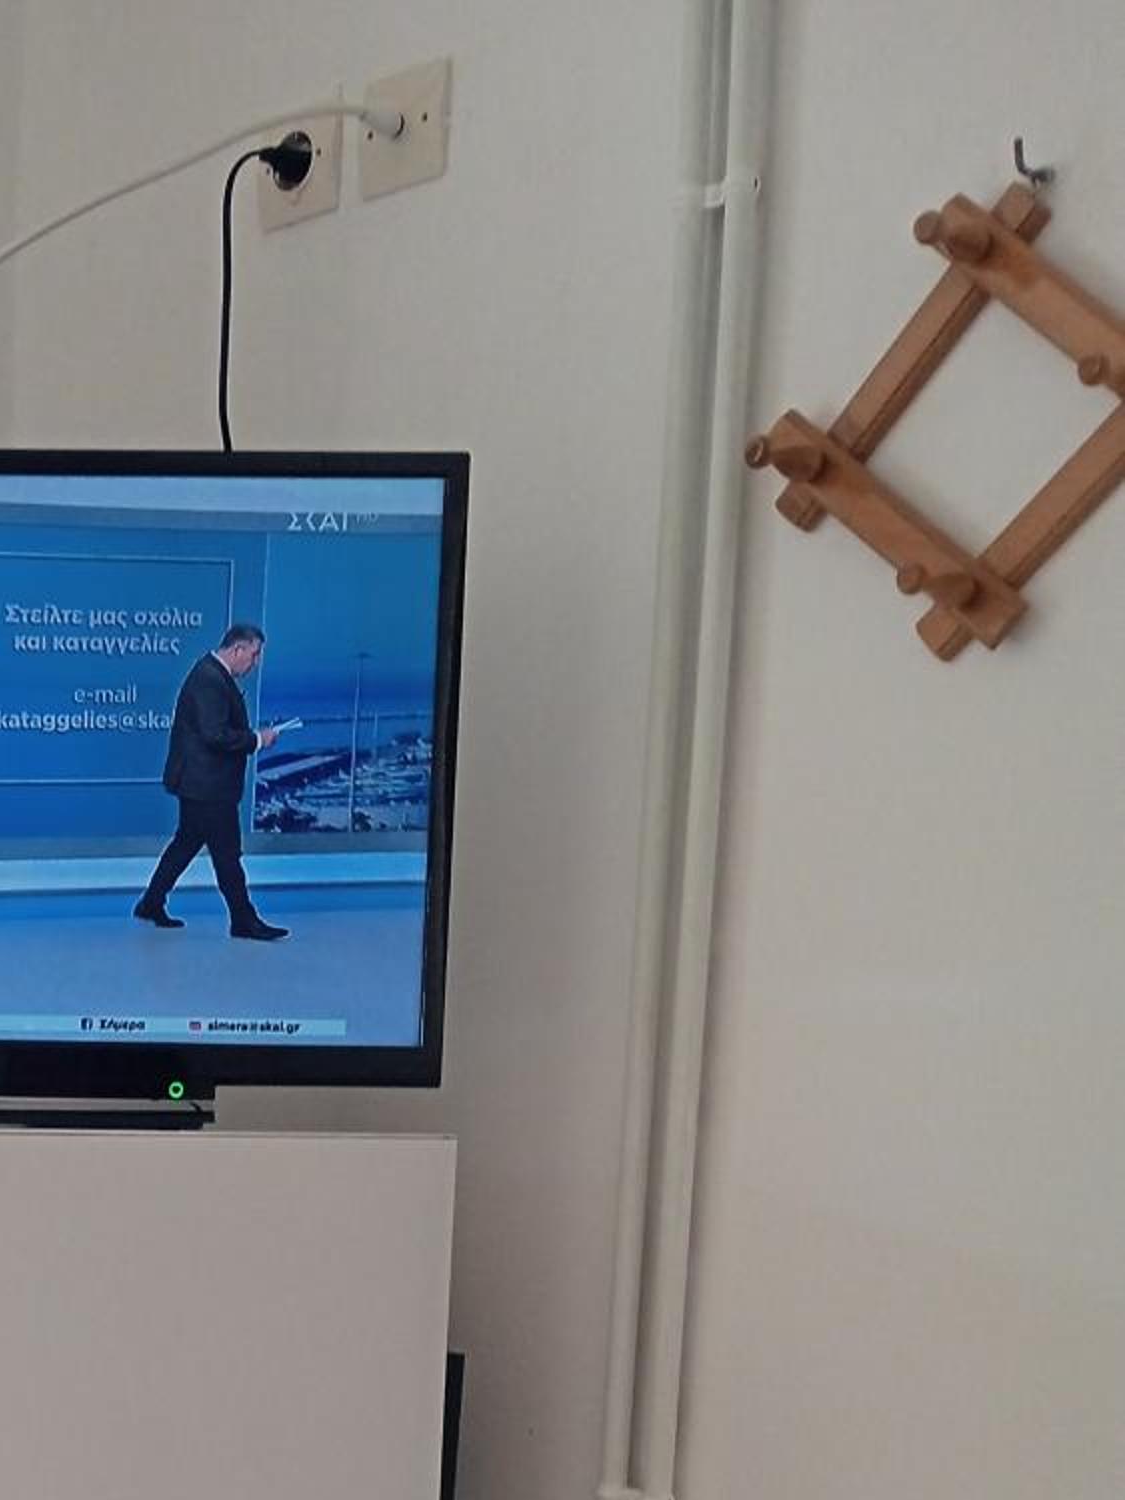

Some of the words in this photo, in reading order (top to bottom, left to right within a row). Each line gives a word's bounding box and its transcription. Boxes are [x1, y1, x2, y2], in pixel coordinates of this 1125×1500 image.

[4, 603, 83, 625] Στείλτε
[89, 608, 129, 629] μας
[134, 607, 203, 629] σχόλια
[14, 634, 46, 651] και
[53, 632, 181, 655] καταγγελίες
[74, 682, 138, 704] e-mail
